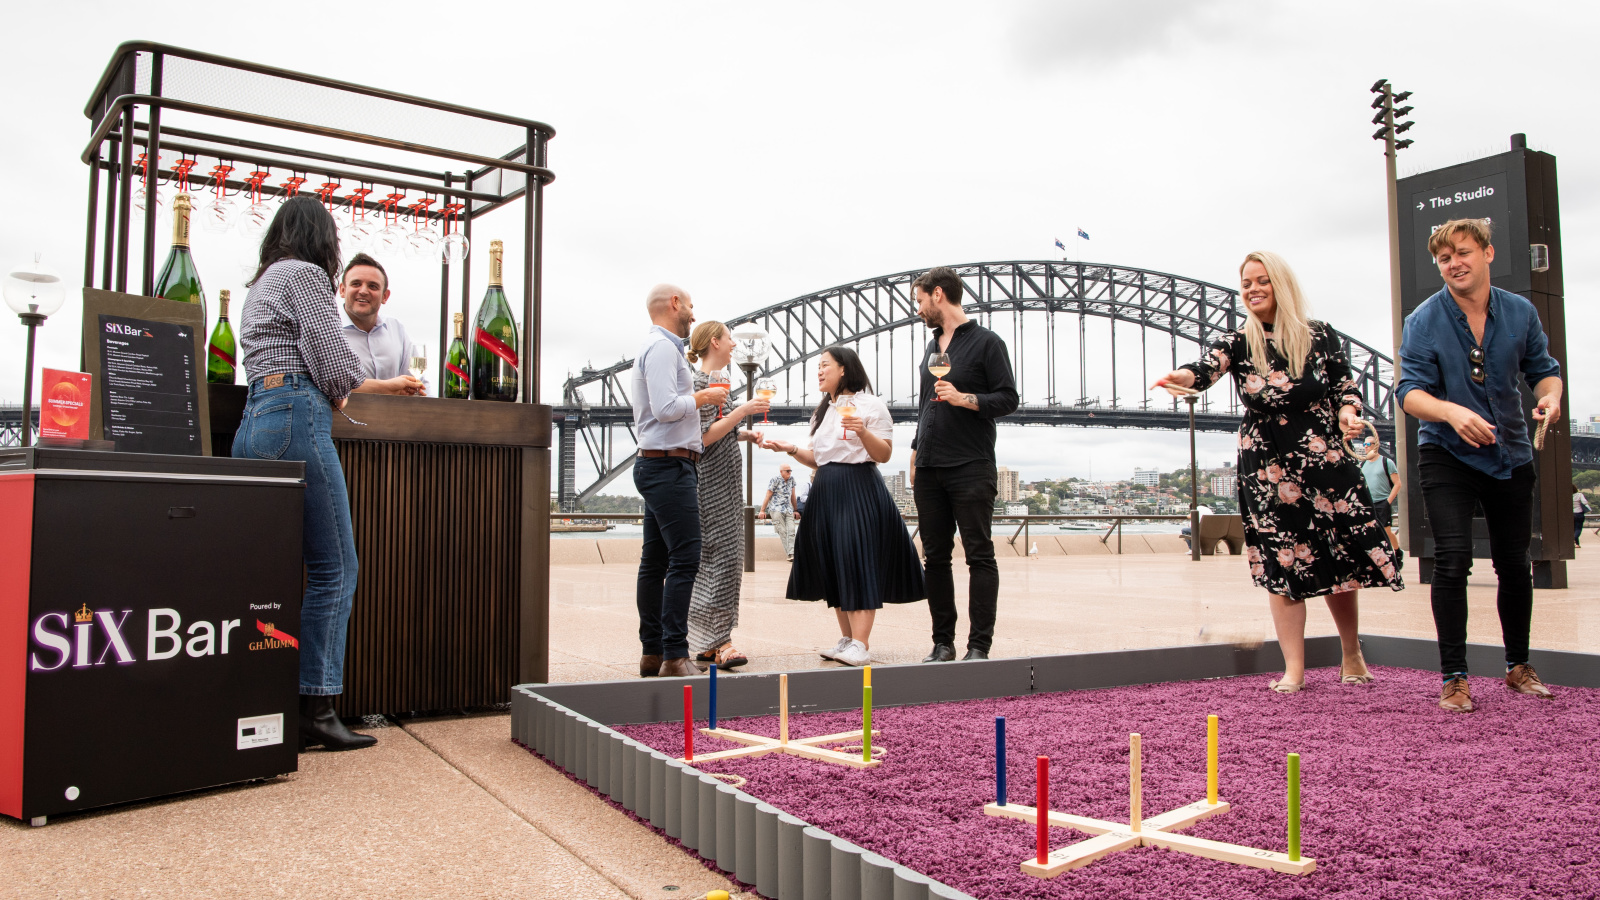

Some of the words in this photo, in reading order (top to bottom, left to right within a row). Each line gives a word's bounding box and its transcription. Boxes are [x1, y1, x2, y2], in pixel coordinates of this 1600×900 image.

[1429, 197, 1452, 209] The
[1454, 186, 1495, 203] Studio
[124, 325, 142, 337] Bar
[265, 376, 282, 388] Lee
[250, 602, 272, 610] Poured
[273, 602, 282, 610] by
[147, 608, 241, 661] Bar
[1254, 850, 1275, 858] 10
